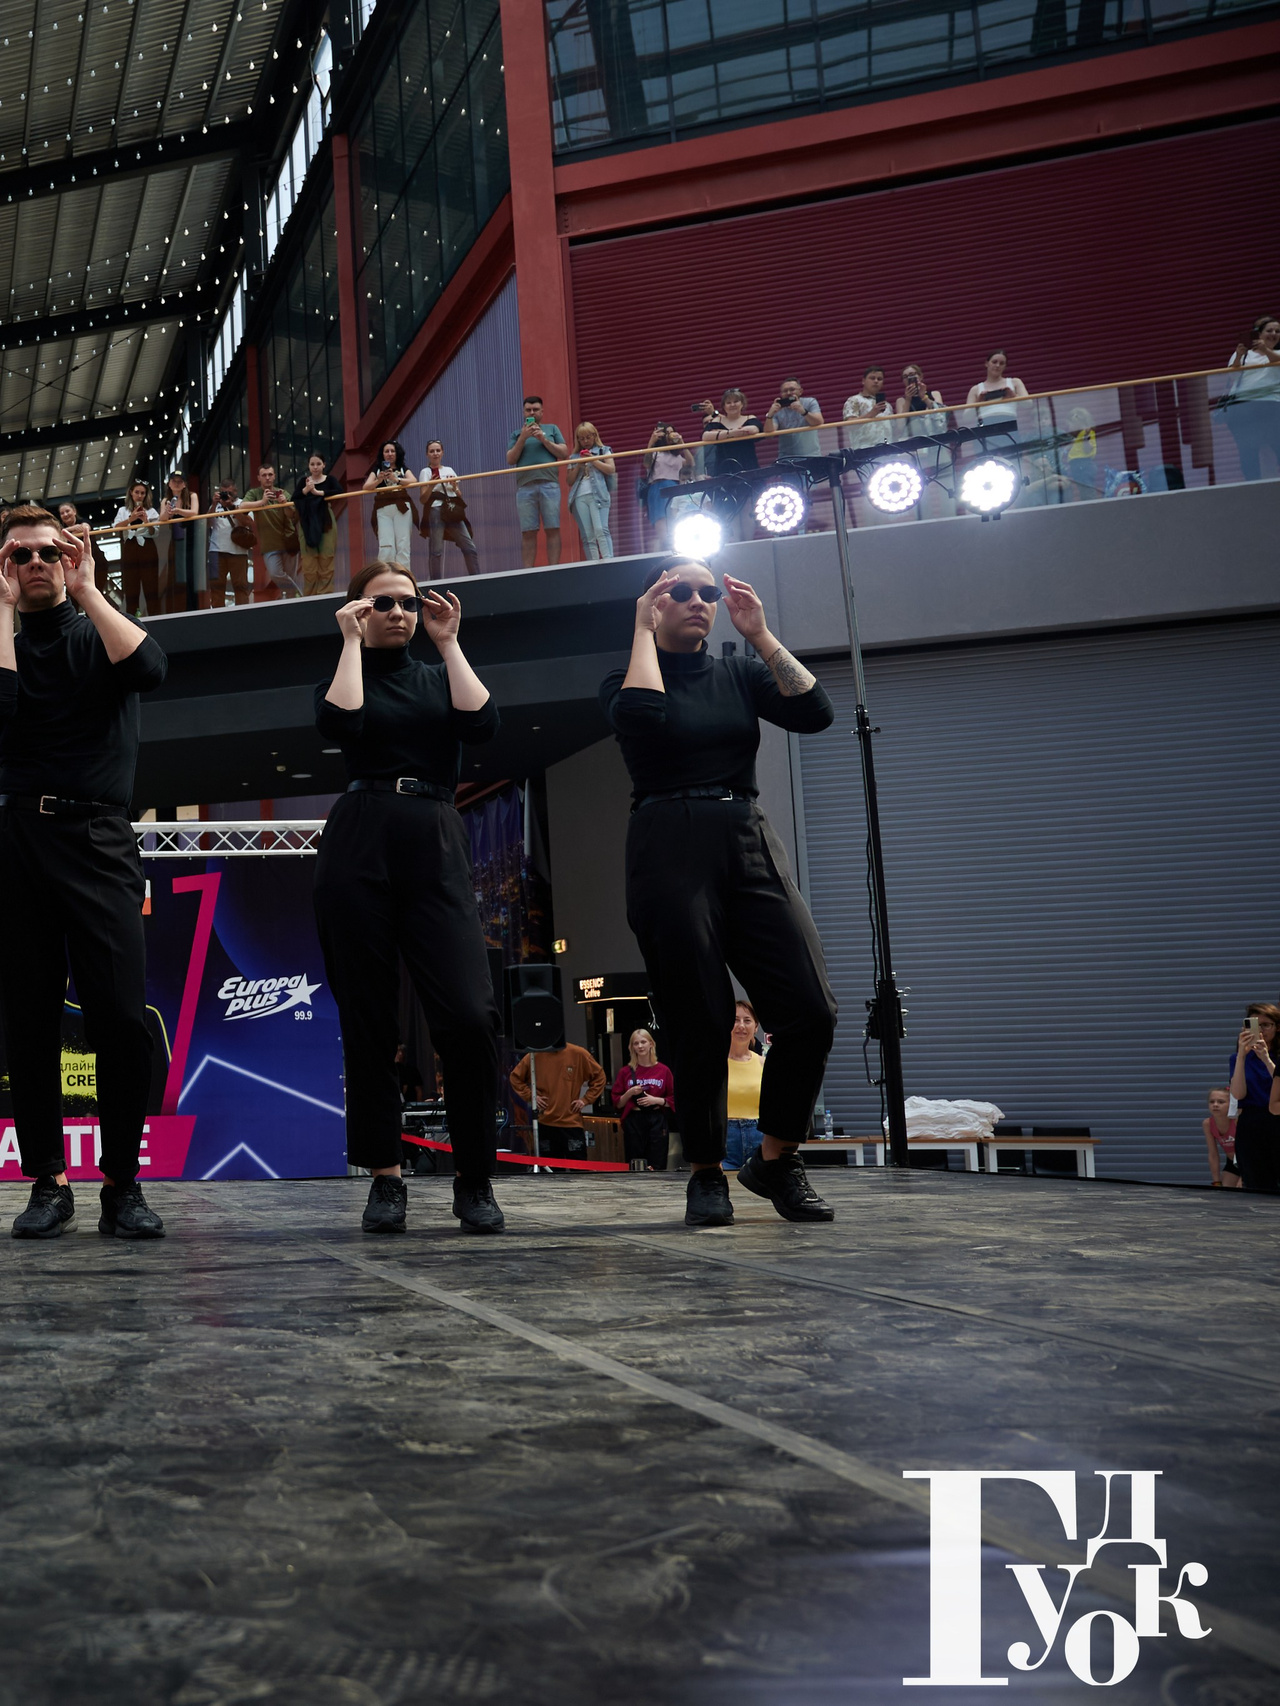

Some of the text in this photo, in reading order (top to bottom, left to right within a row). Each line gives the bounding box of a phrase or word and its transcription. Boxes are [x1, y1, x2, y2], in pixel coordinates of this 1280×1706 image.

[217, 974, 302, 1000] Europa
[294, 1010, 313, 1021] 99.9
[66, 1074, 96, 1087] CRE
